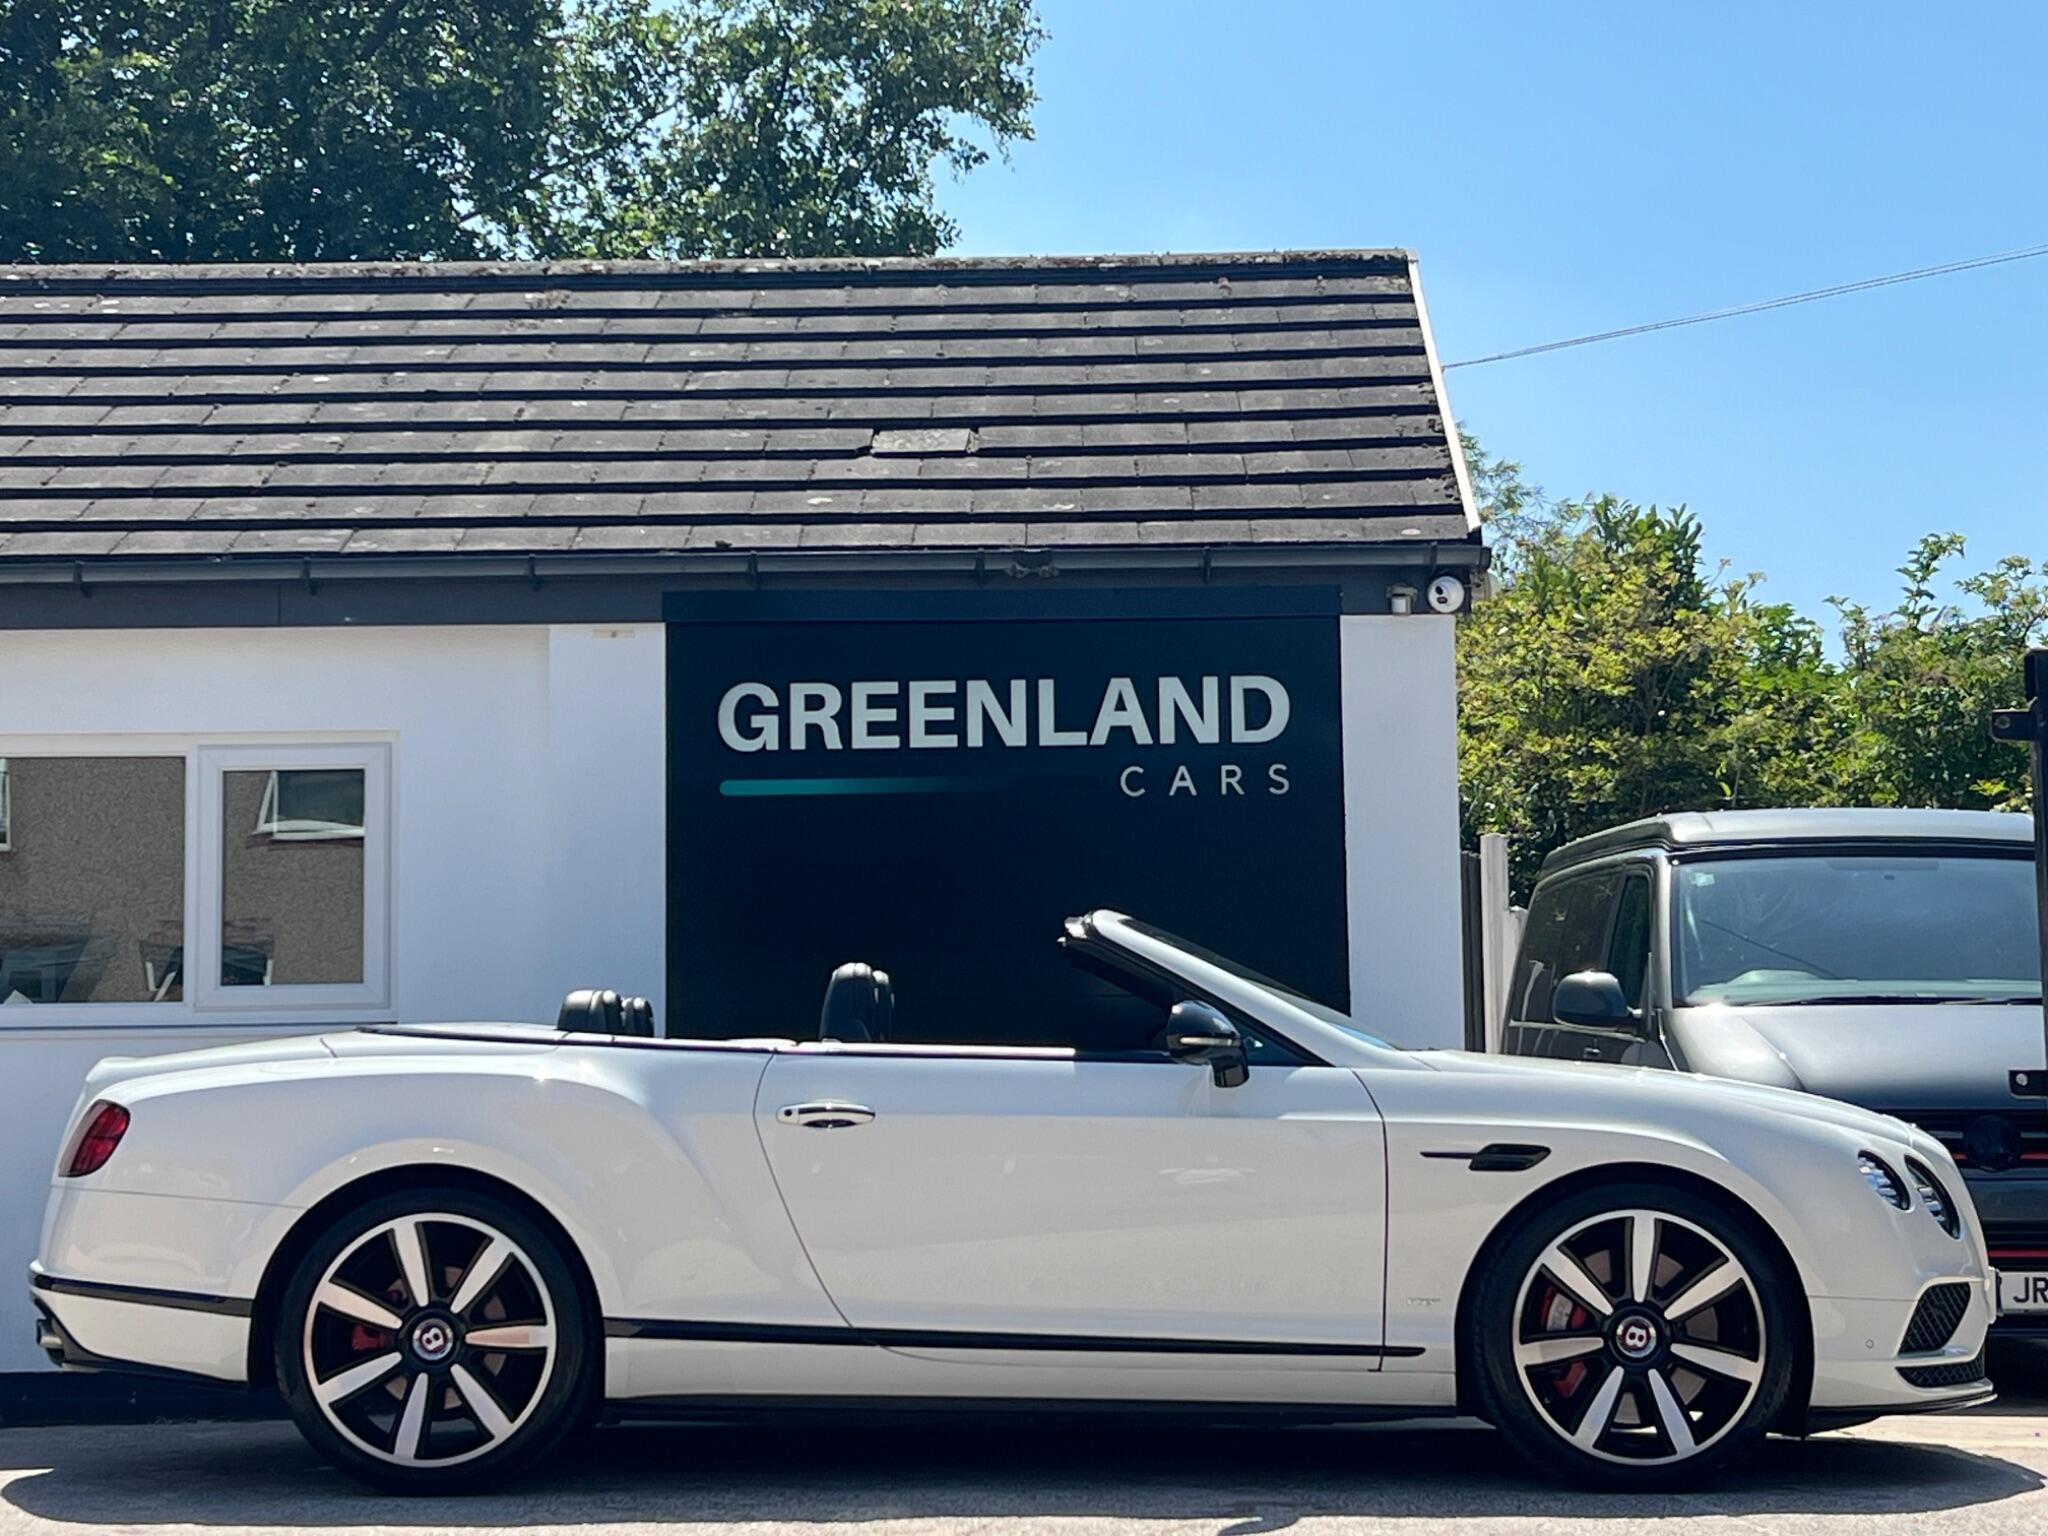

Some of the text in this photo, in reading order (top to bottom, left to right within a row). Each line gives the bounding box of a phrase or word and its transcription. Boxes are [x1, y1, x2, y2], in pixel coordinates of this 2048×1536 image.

[718, 676, 1290, 752] GREENLAND
[1120, 764, 1290, 796] CARS
[2013, 1277, 2048, 1303] JR
